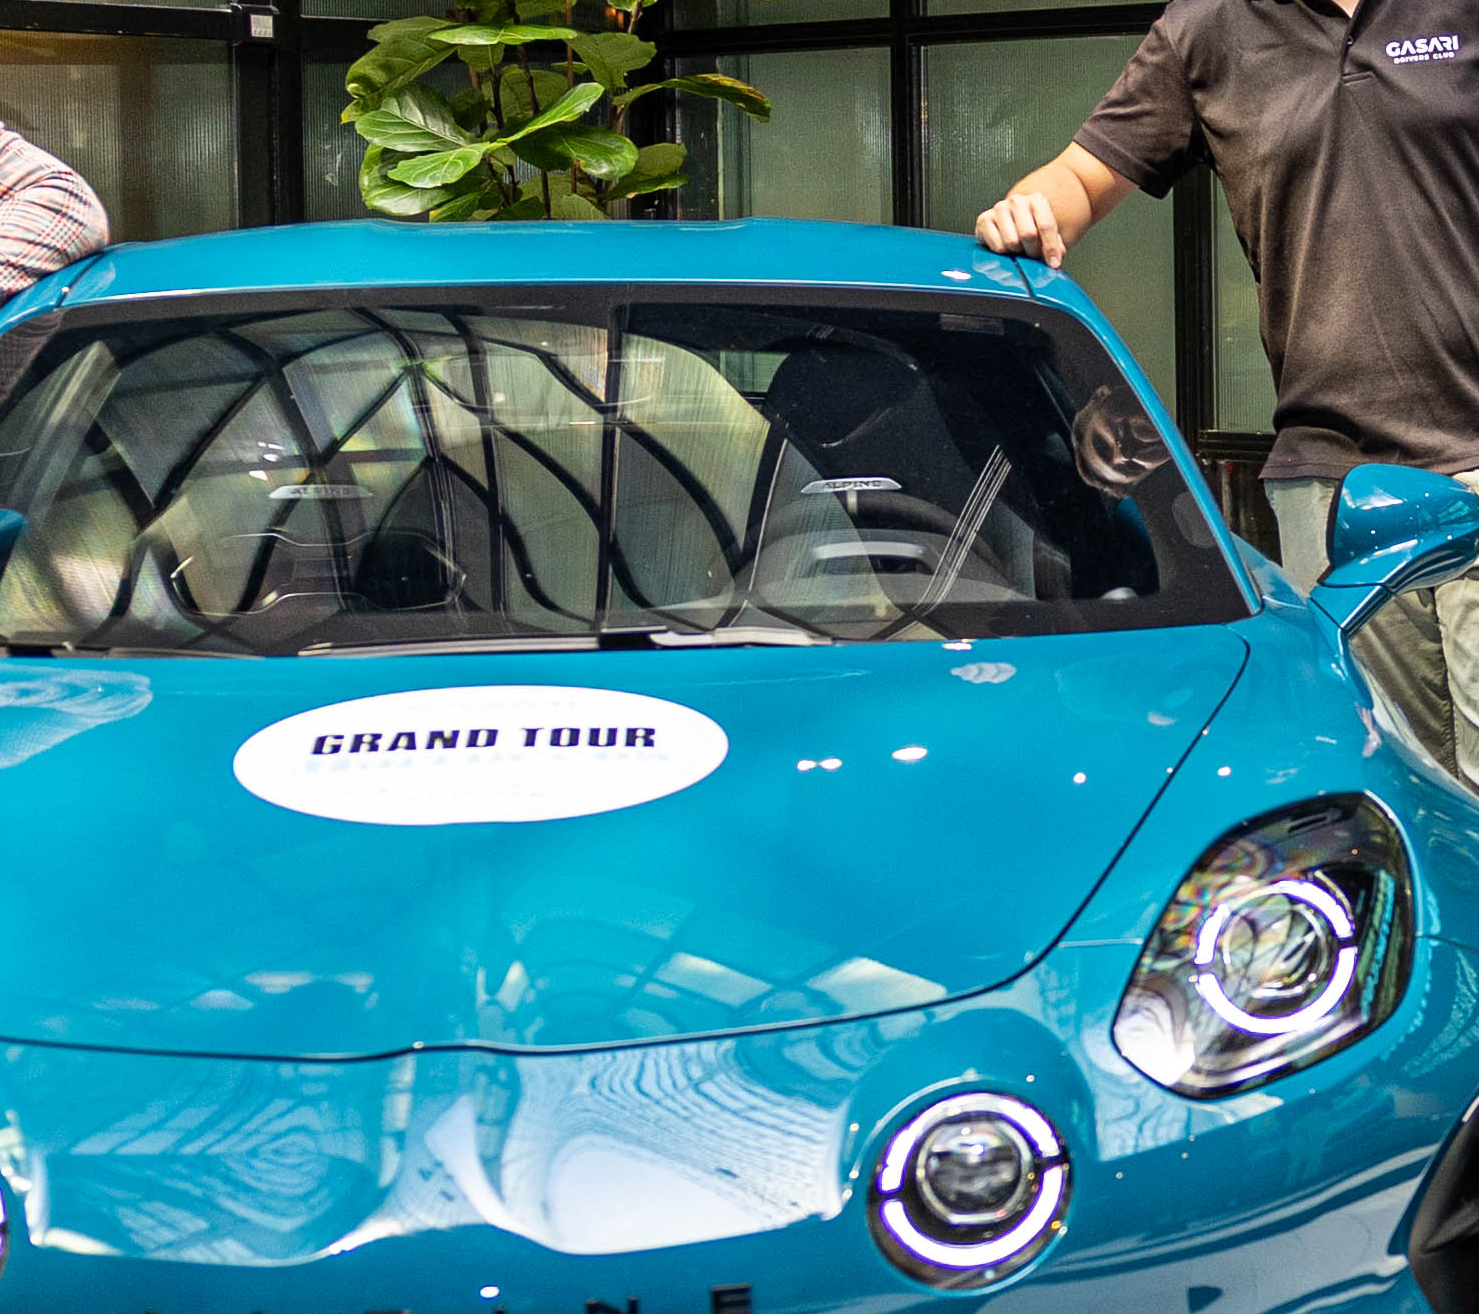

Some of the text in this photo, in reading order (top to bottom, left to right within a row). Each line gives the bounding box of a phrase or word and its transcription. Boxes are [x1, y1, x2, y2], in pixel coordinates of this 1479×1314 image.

[1385, 34, 1460, 57] GASARI
[310, 726, 657, 755] GRAND TOUR
